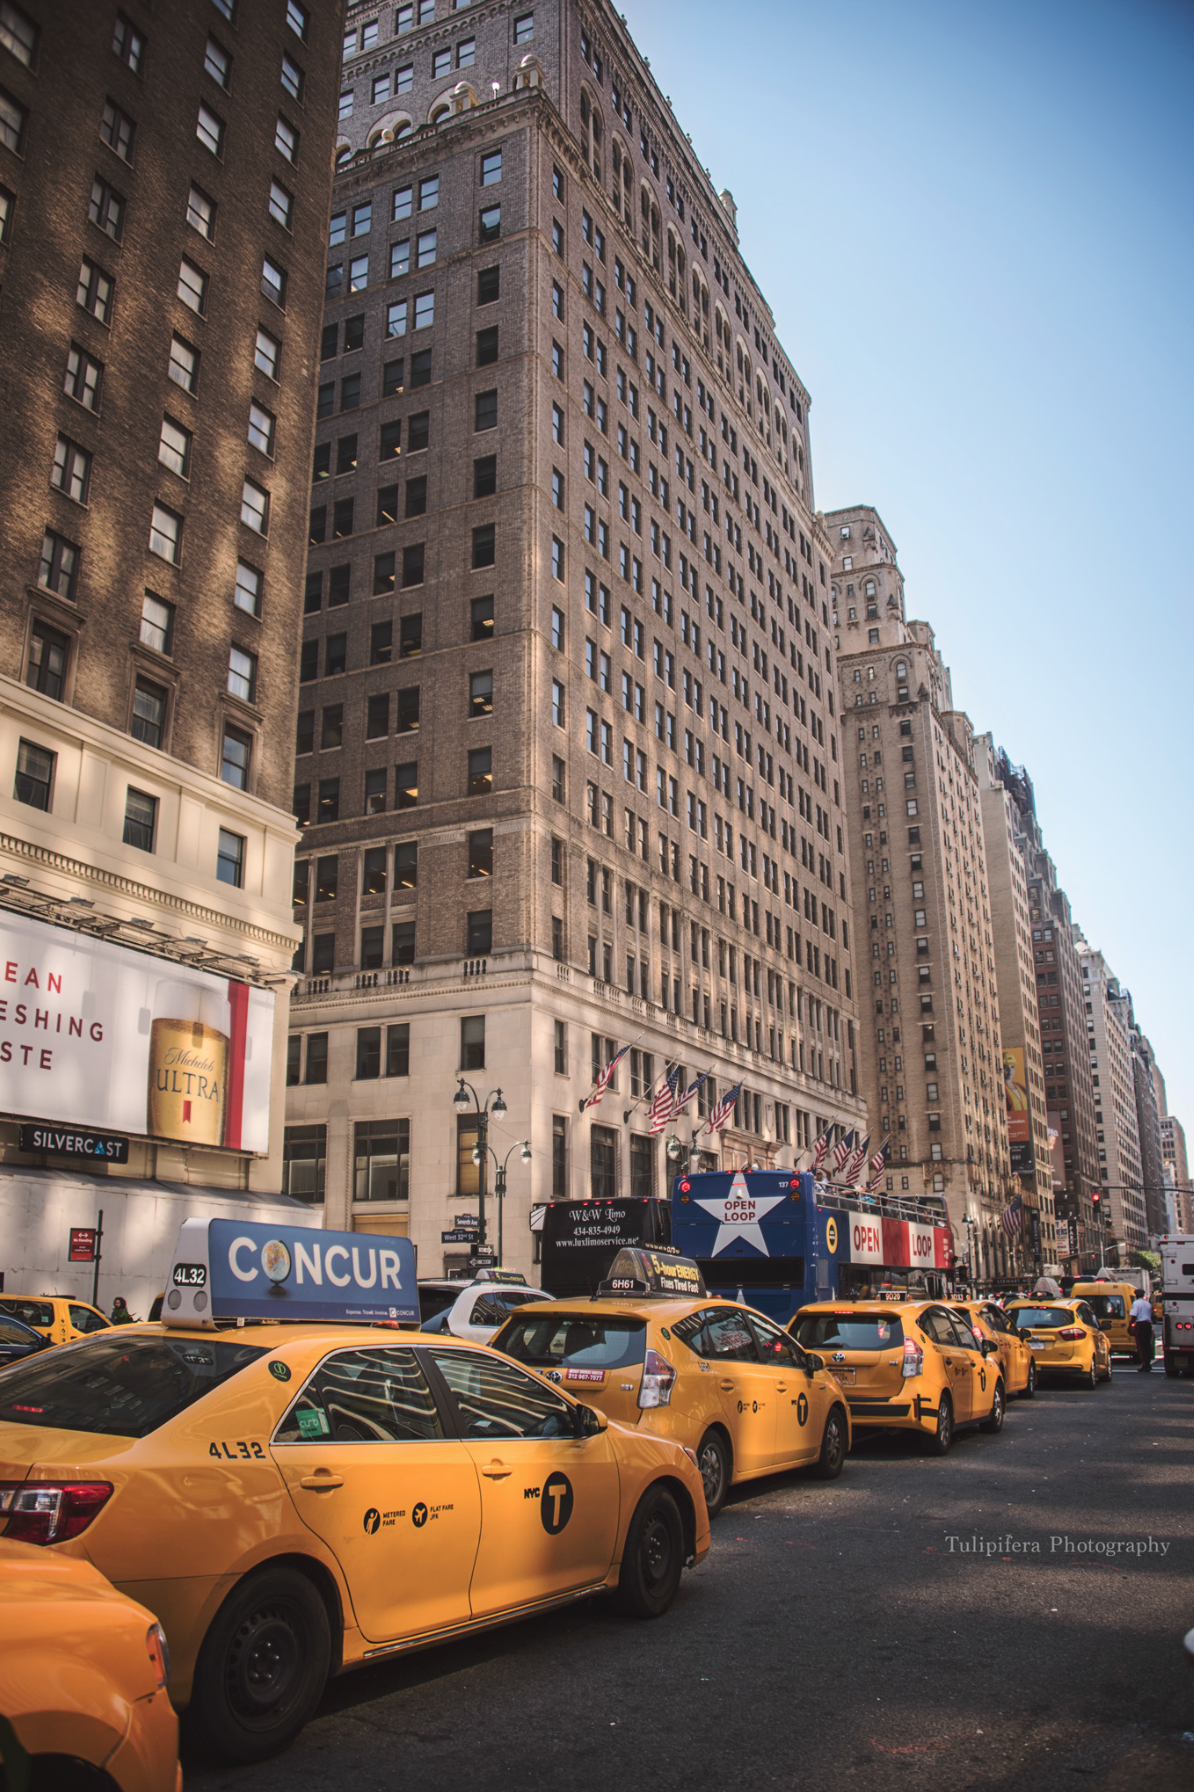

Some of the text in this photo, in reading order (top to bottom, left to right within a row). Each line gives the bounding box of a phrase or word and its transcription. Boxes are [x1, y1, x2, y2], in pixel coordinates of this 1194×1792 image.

[5, 961, 62, 994] EAN
[0, 1041, 53, 1070] STE
[164, 1047, 214, 1072] Michelob
[157, 1069, 219, 1102] ULTRA
[724, 1200, 756, 1210] OPEN
[569, 1208, 626, 1223] W&W Limo
[724, 1212, 756, 1221] LOOP
[573, 1225, 621, 1236] 434-835-4949
[853, 1224, 880, 1253] OPEN
[911, 1233, 932, 1258] LOOP
[174, 1267, 205, 1284] 4L32
[612, 1279, 634, 1289] 6H61
[660, 1276, 699, 1293] Fixes Tired Fast
[799, 1399, 806, 1422] T
[300, 1418, 319, 1428] curb
[209, 1441, 266, 1459] 4L32
[430, 1503, 454, 1513] FLAT FARE
[524, 1484, 567, 1527] NYC T
[383, 1510, 406, 1519] METERED
[383, 1519, 395, 1527] FARE
